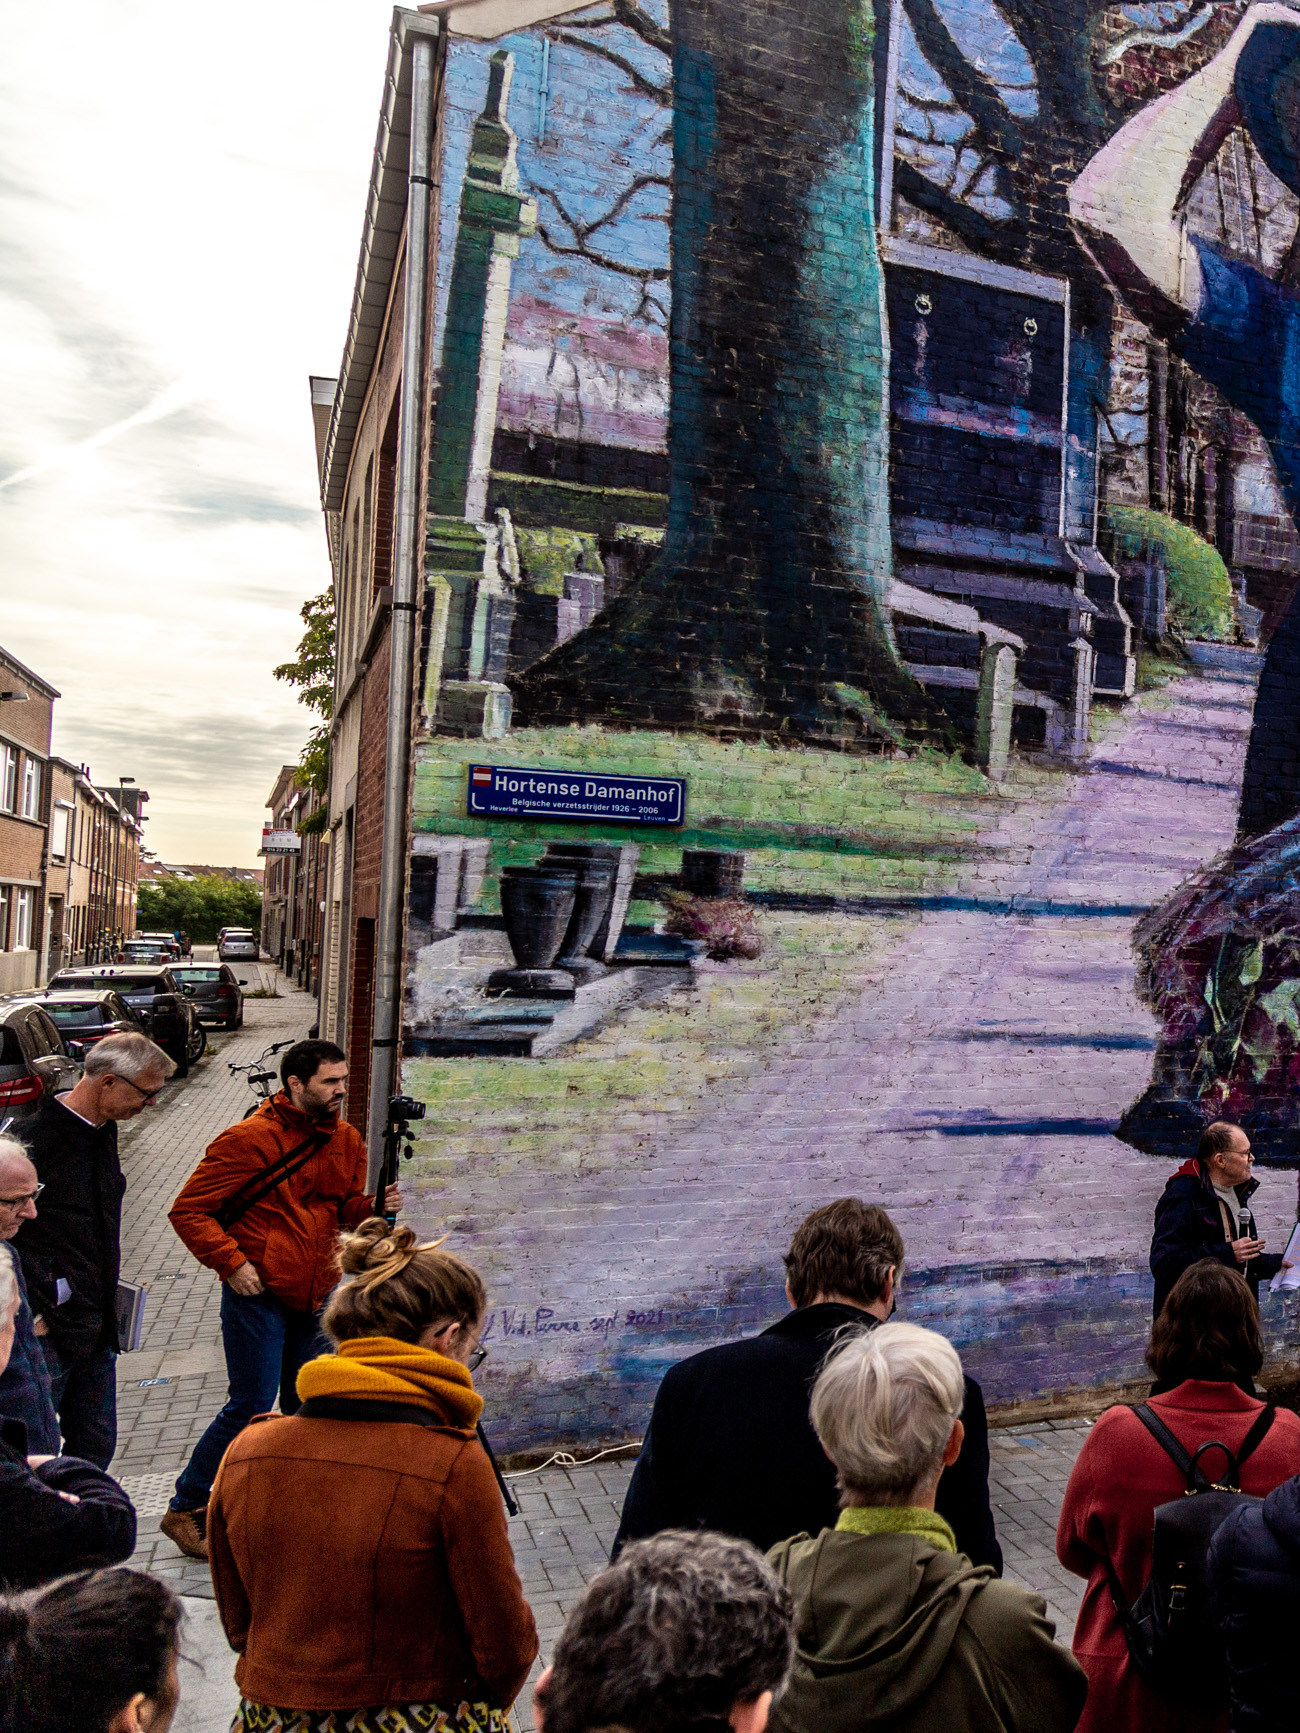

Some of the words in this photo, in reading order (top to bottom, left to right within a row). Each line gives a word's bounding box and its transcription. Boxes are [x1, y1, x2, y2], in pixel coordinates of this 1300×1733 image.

[495, 775, 580, 796] Hortense
[585, 781, 675, 802] Damanhof
[490, 804, 518, 812] Heverlee
[512, 798, 551, 808] Belgische
[552, 802, 610, 812] verzetsstrijder
[612, 804, 630, 813] 1926
[638, 806, 659, 814] 2006
[643, 814, 666, 822] Leuven
[624, 1309, 664, 1327] 2021
